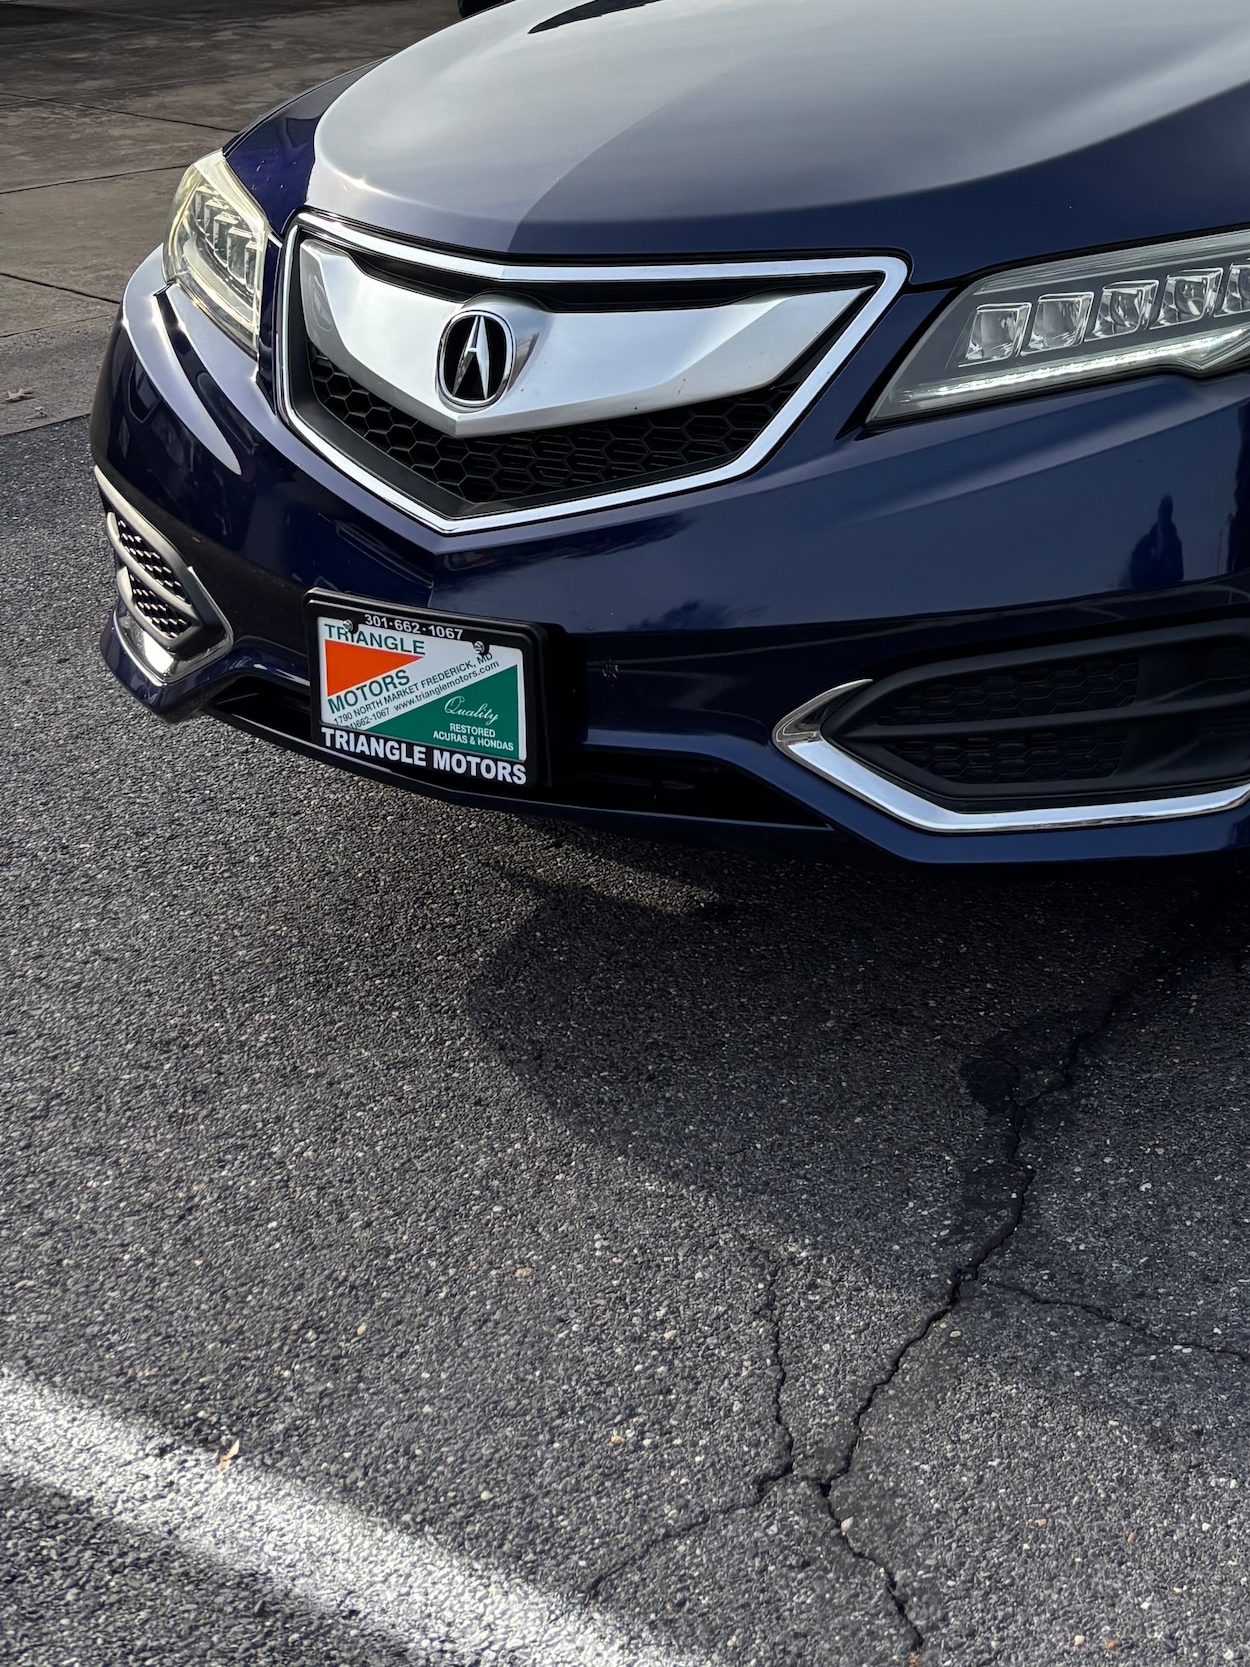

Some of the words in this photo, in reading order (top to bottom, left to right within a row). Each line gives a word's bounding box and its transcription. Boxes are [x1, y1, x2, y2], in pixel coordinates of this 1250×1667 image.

[324, 623, 426, 655] TRIANGLE
[328, 668, 410, 714] MOTORS
[353, 699, 383, 717] NORTH
[383, 683, 419, 705] MARKET
[421, 660, 477, 689] FREDERICK,
[477, 651, 493, 664] MD
[393, 660, 500, 712] www.trianglemotors.com
[444, 695, 499, 726] Quality
[432, 730, 468, 744] ACURAS
[469, 736, 476, 745] &
[478, 738, 514, 751] HONDAS
[450, 723, 496, 738] RESTORED
[321, 726, 427, 766] TRIANGLE
[433, 749, 527, 784] MOTORS
